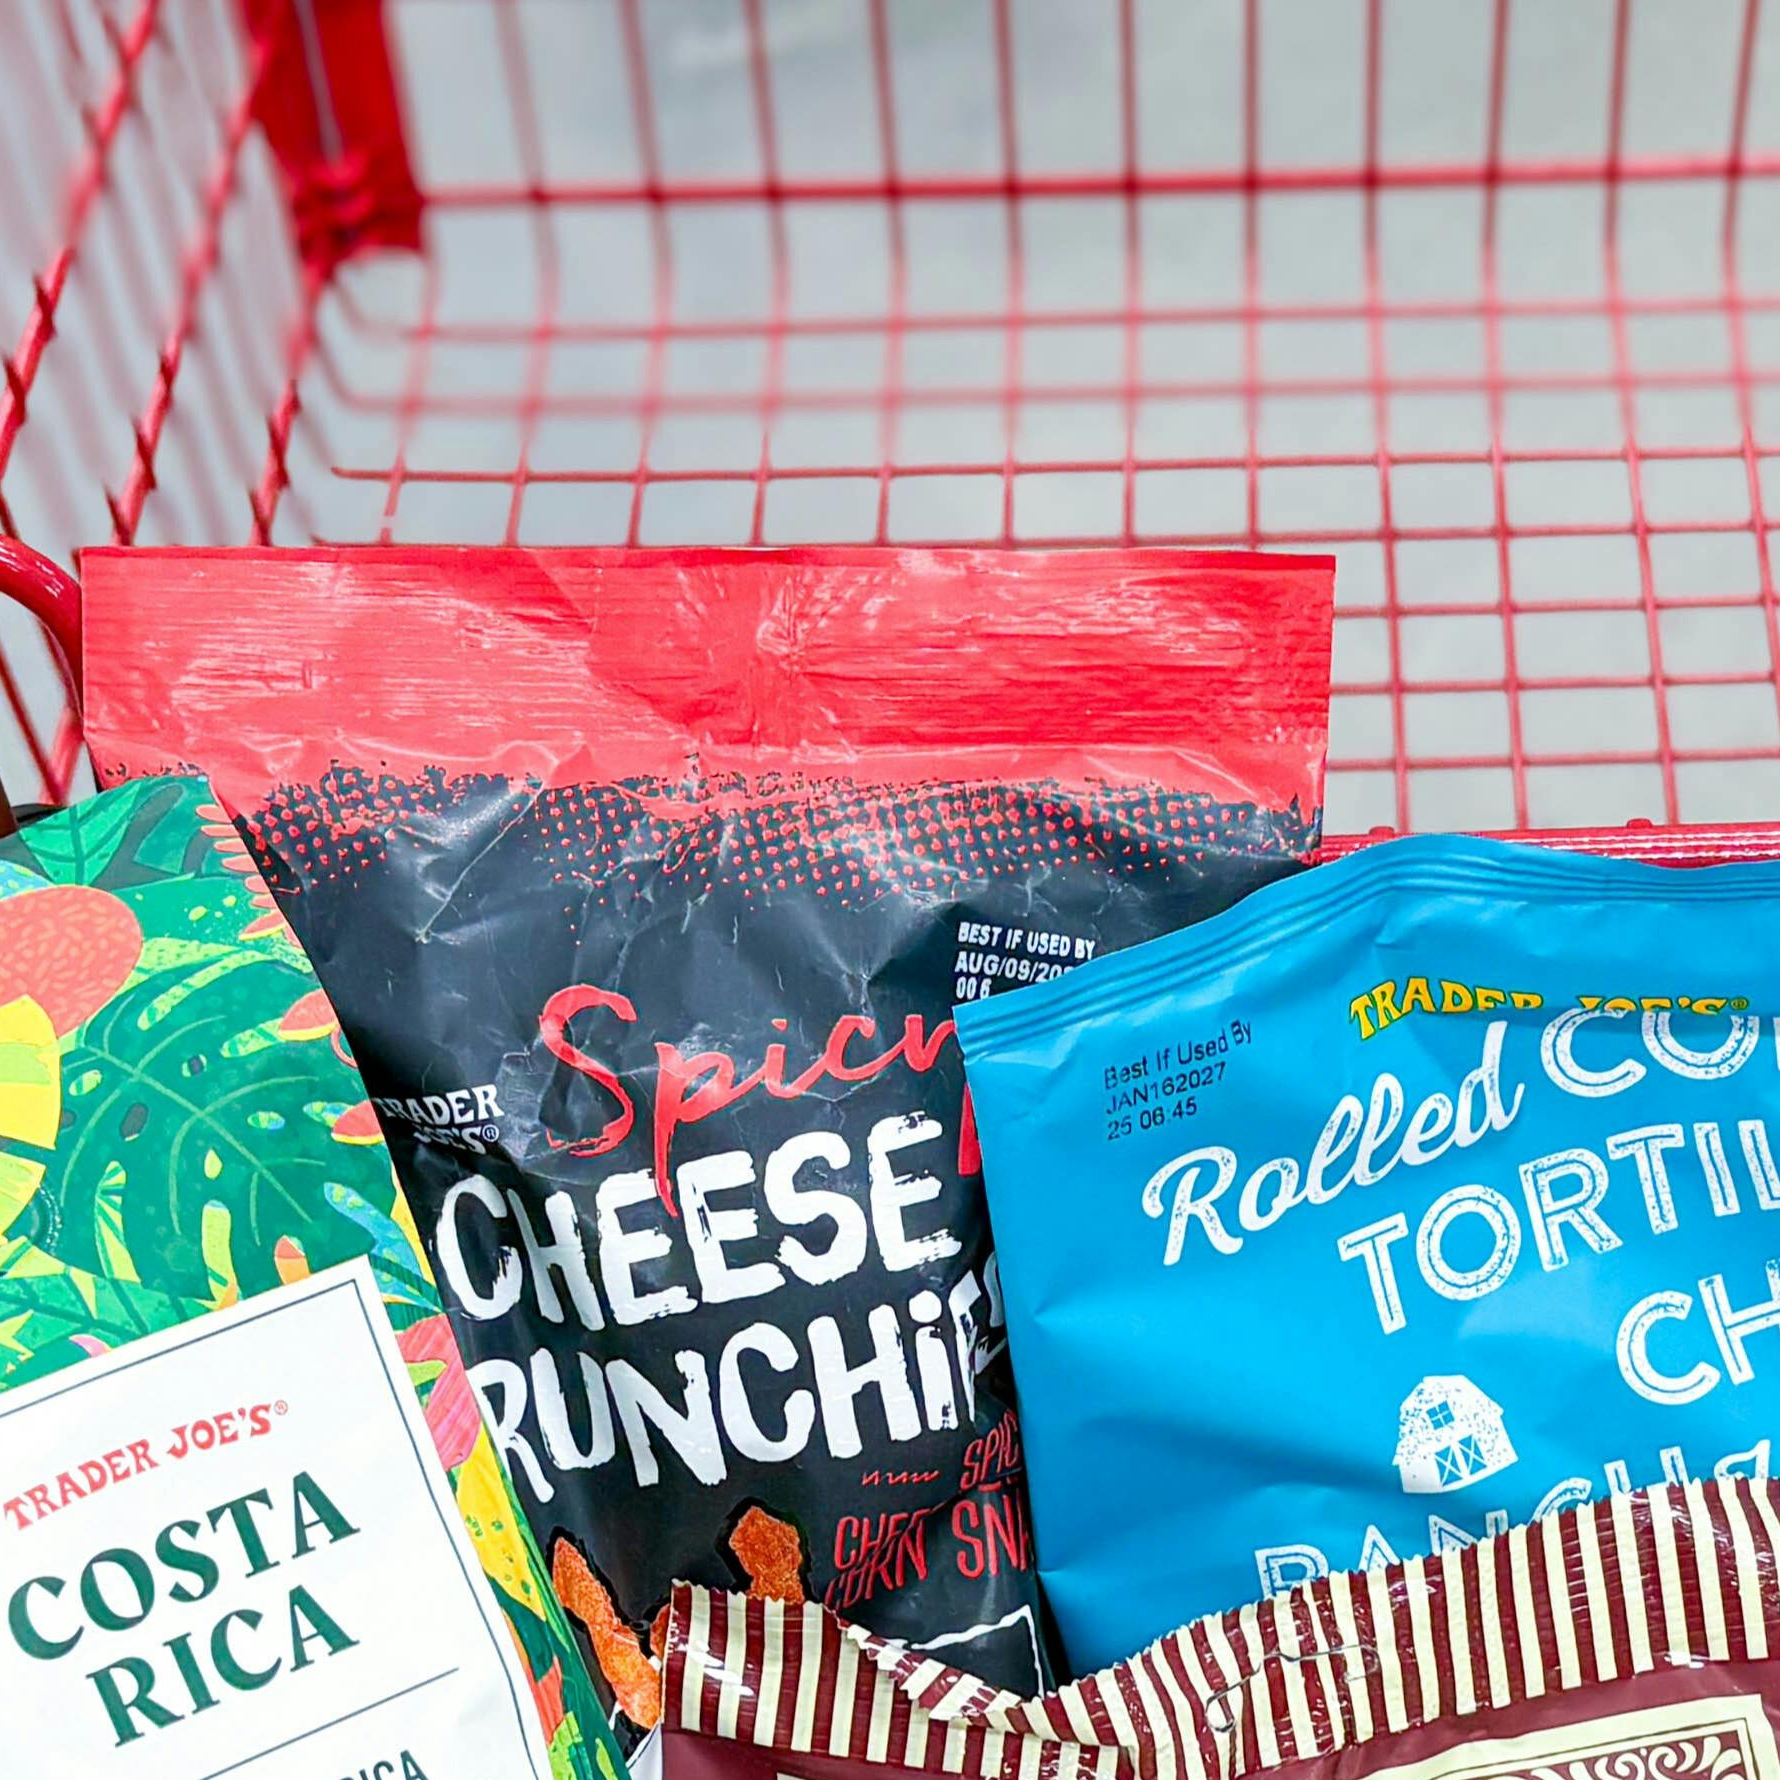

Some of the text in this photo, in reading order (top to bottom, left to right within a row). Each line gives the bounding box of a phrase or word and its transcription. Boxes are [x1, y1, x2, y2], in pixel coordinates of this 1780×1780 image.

[957, 921, 1096, 960] BEST IF USED BY
[1104, 1019, 1253, 1091] Best If Used By
[1106, 1061, 1227, 1115] JAN162027
[1107, 1115, 1133, 1141] 25
[1141, 1022, 1525, 1266] Rolled
[431, 1110, 965, 1332] CHEESE
[2, 1438, 161, 1531] TRADER
[6, 1469, 362, 1661] COSTA
[85, 1583, 361, 1749] RICA
